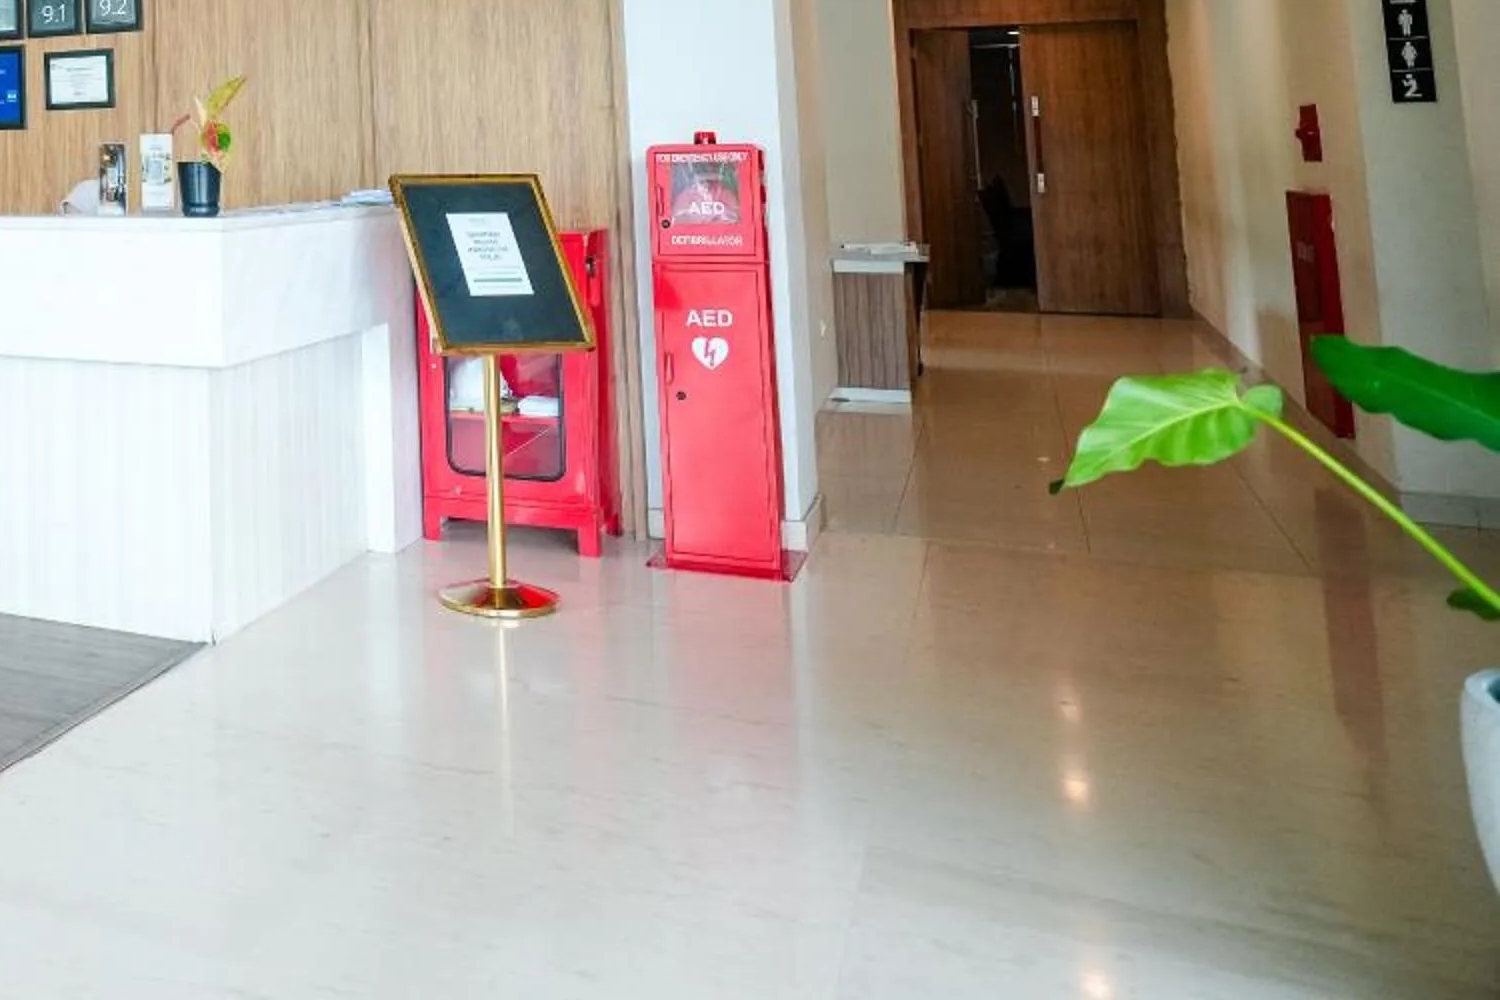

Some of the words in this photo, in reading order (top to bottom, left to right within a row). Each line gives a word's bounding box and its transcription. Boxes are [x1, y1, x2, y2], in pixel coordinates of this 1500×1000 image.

[41, 3, 67, 25] 9.1
[689, 201, 725, 215] AED
[686, 309, 733, 327] AED
